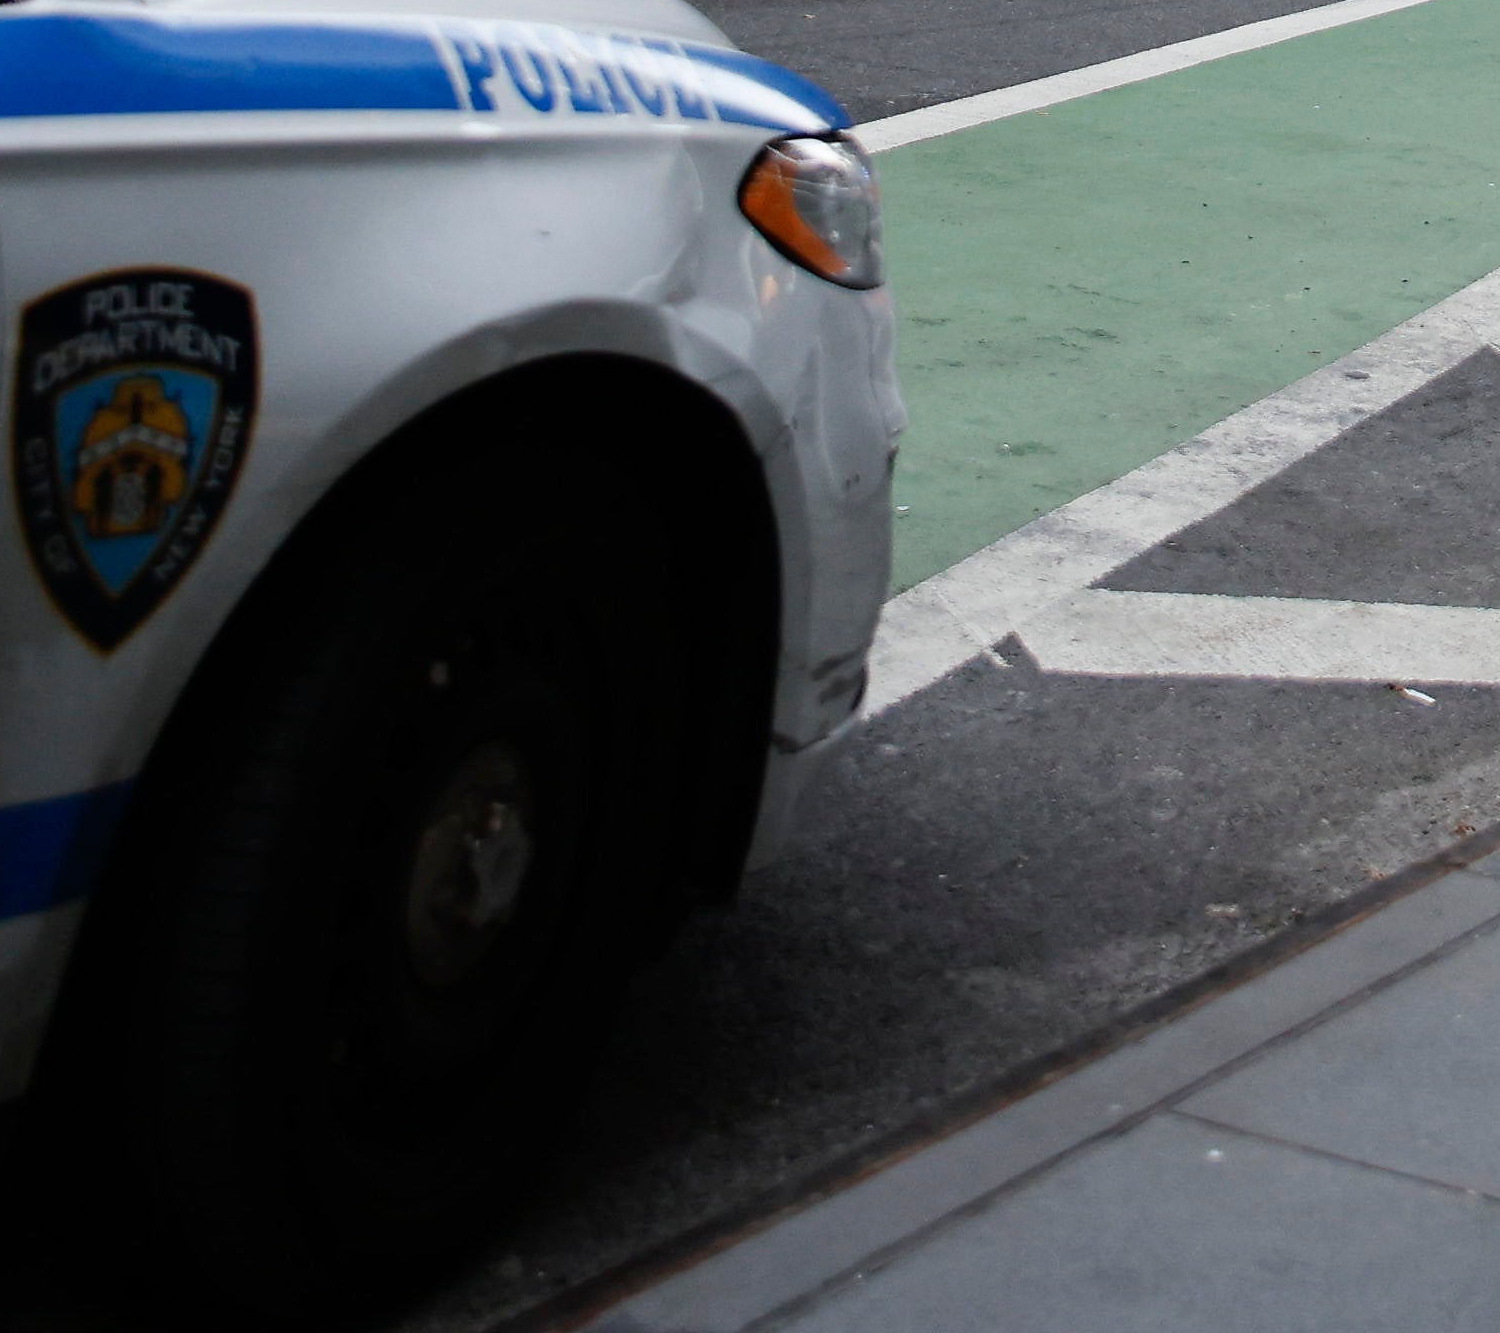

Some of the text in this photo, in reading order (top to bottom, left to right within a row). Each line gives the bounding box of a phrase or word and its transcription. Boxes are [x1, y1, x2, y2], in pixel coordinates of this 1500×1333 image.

[438, 23, 722, 122] POLICE
[86, 282, 195, 327] POLICE
[33, 320, 244, 395] DEPARTMENT
[202, 405, 244, 489] YORK
